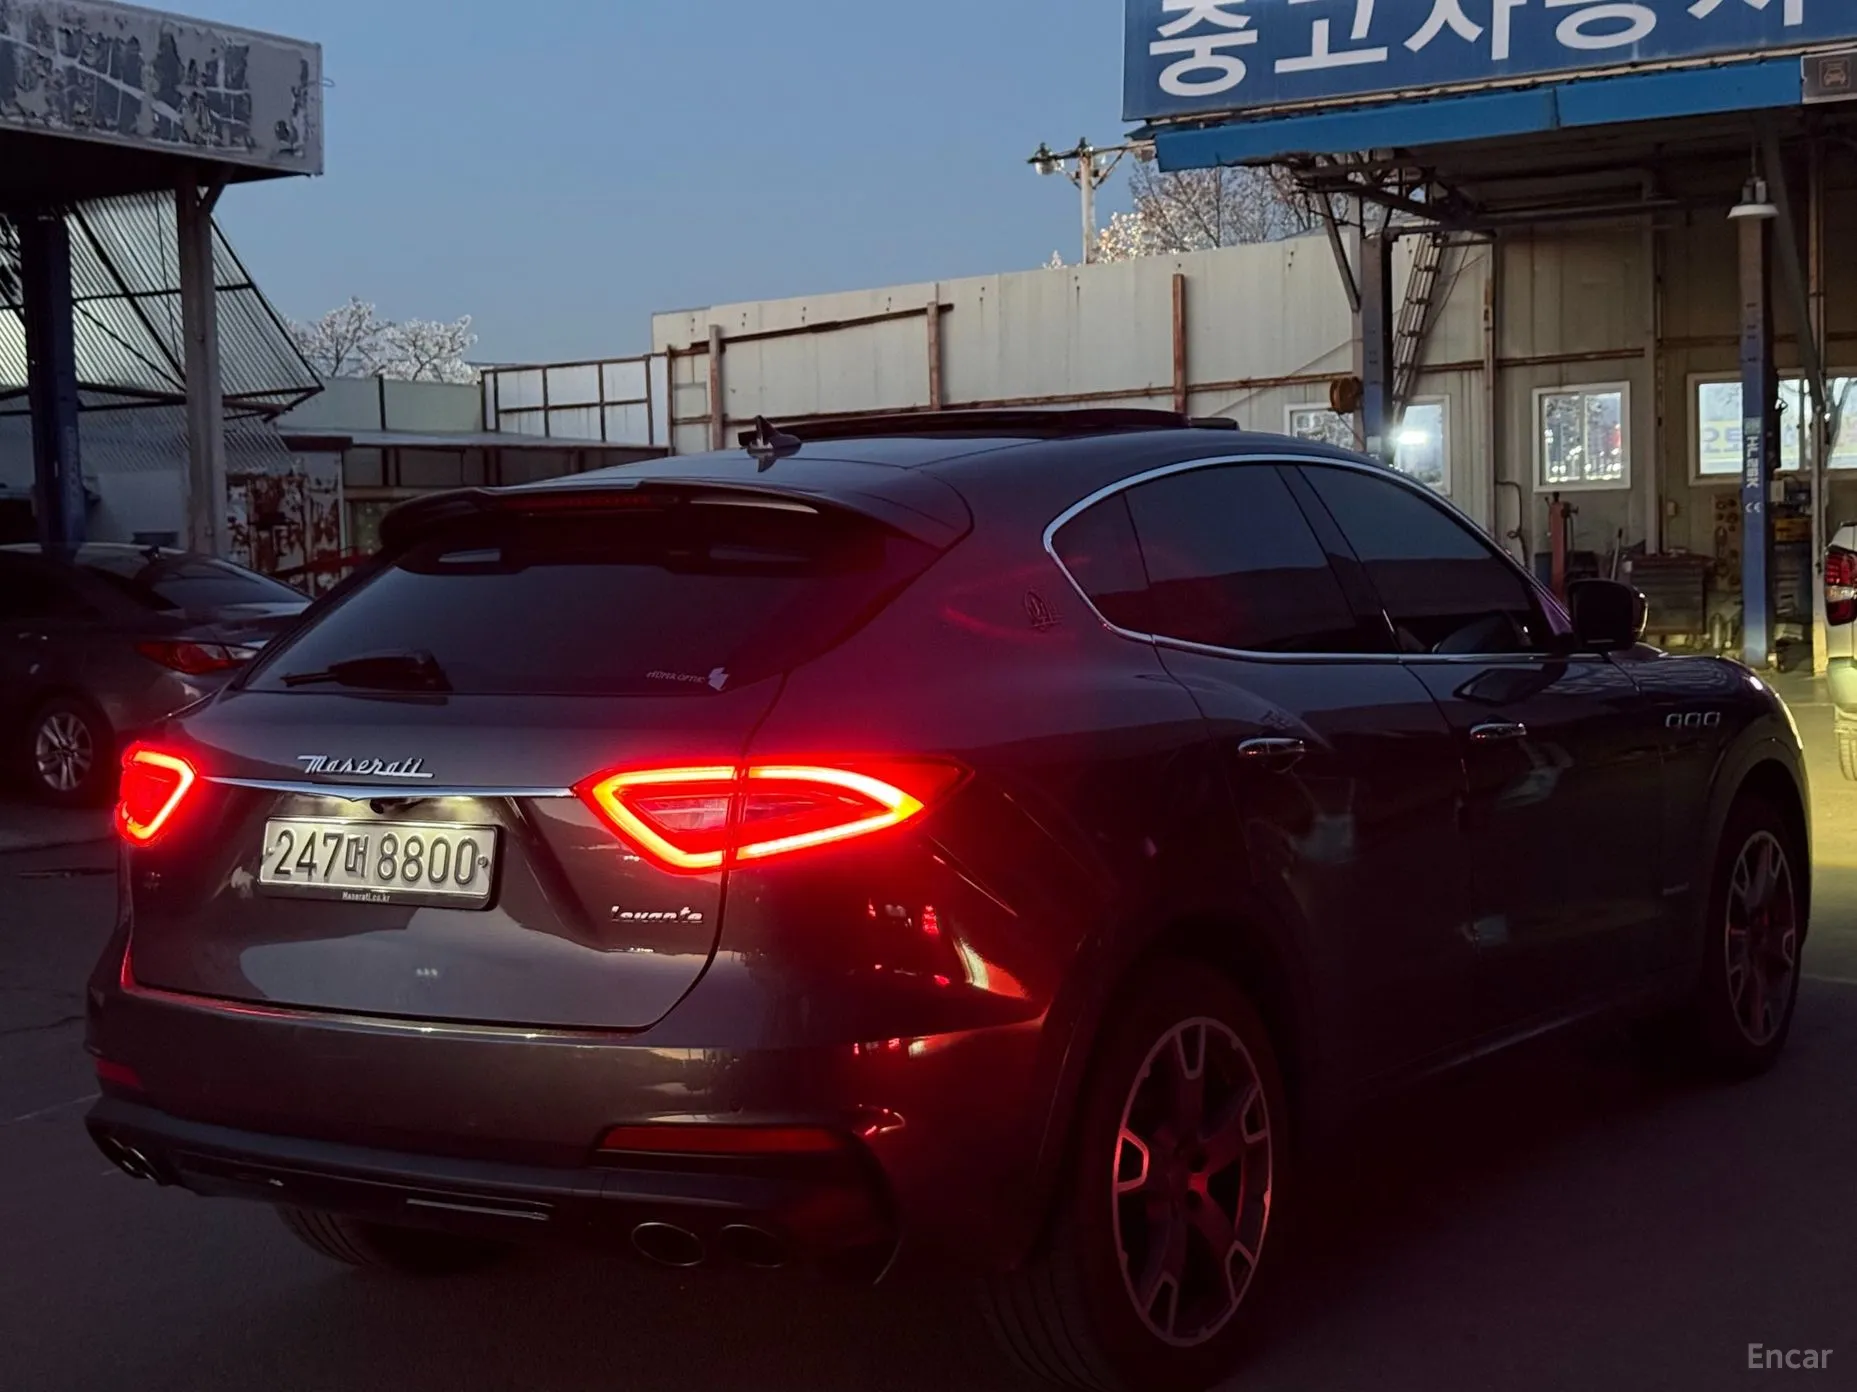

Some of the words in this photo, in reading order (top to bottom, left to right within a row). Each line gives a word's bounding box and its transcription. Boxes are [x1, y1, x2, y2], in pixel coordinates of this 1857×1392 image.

[297, 755, 434, 778] Maserati
[274, 828, 370, 878] 247머
[376, 831, 478, 886] 8800
